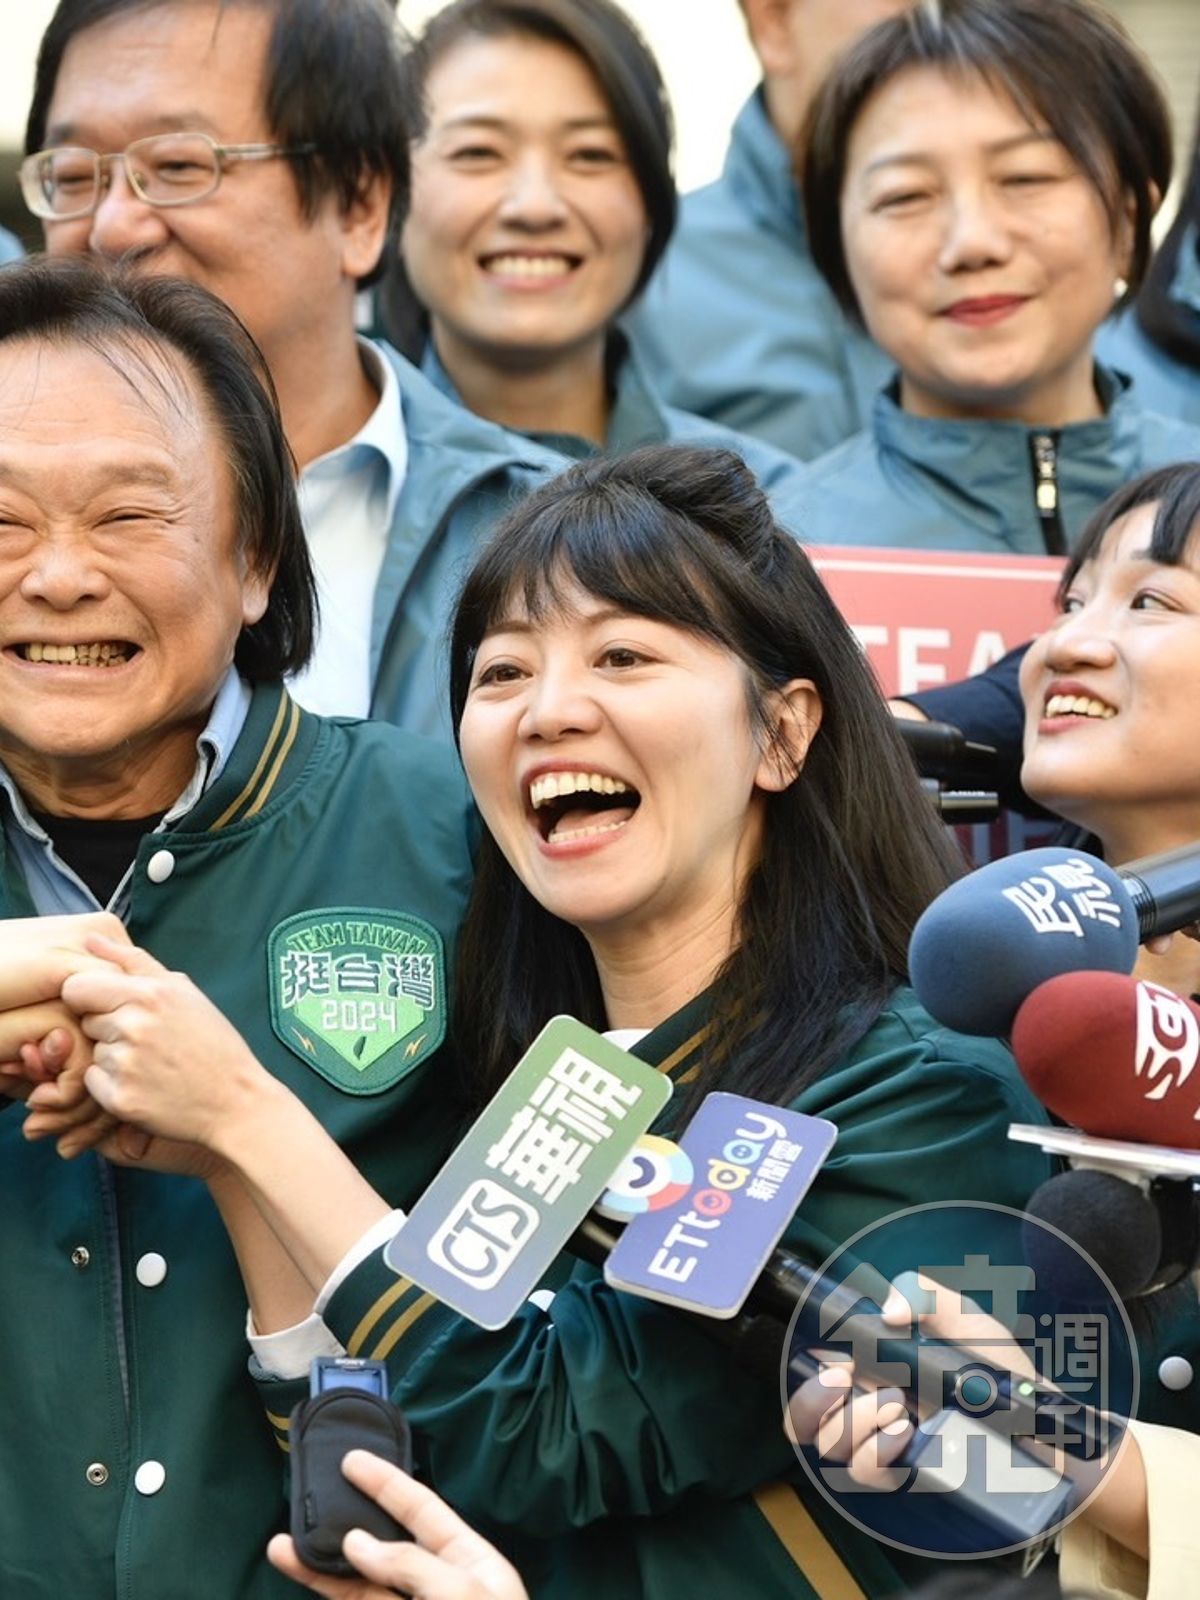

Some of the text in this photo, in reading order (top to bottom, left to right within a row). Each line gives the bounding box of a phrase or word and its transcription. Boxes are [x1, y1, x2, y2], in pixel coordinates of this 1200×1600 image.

[849, 624, 1012, 698] EA
[1002, 855, 1122, 938] 民視
[287, 920, 428, 957] TEAM TAIWAN
[280, 950, 436, 1011] 挺台灣
[321, 999, 399, 1033] 2024
[438, 1046, 643, 1281] CTS 華視
[746, 1140, 804, 1201] 新聞雲
